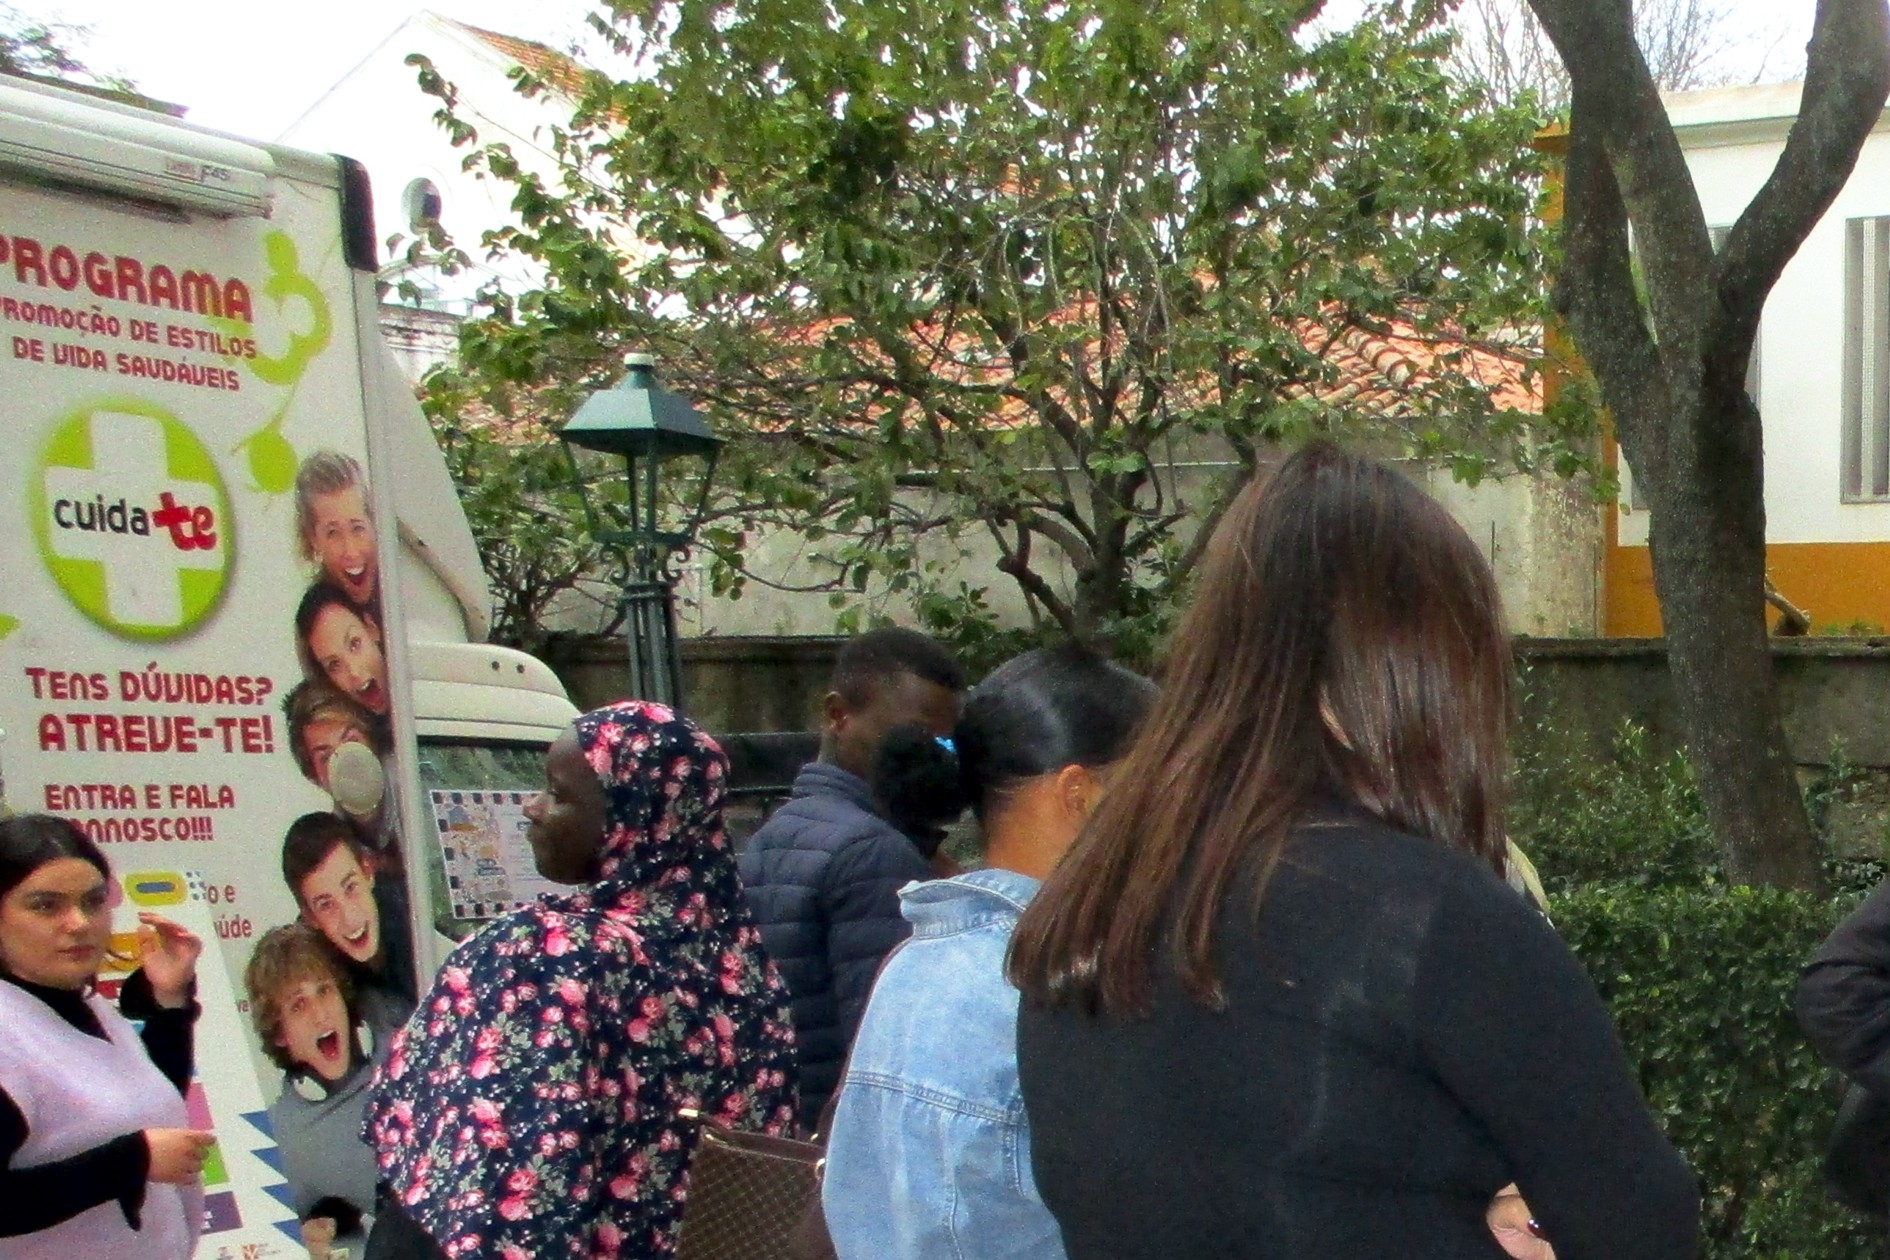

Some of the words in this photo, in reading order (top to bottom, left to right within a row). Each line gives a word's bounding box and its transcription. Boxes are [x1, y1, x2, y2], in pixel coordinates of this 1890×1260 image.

[0, 234, 254, 323] ROGRAMA
[0, 298, 120, 338] ROMOÇÃO
[130, 319, 158, 343] DE
[167, 325, 257, 359] ESTILOS
[13, 336, 44, 362] DE
[53, 343, 107, 371] VIDA
[116, 356, 240, 391] SAUDÁVEIS
[25, 667, 109, 700] TENS
[119, 661, 274, 705] DÚVIDAS?
[39, 714, 274, 753] ATREVE-TE!
[45, 784, 137, 811] ENTRA
[145, 784, 162, 809] E
[169, 784, 235, 809] FALA
[68, 816, 213, 843] NNOSCO!!!
[214, 914, 252, 939] úde
